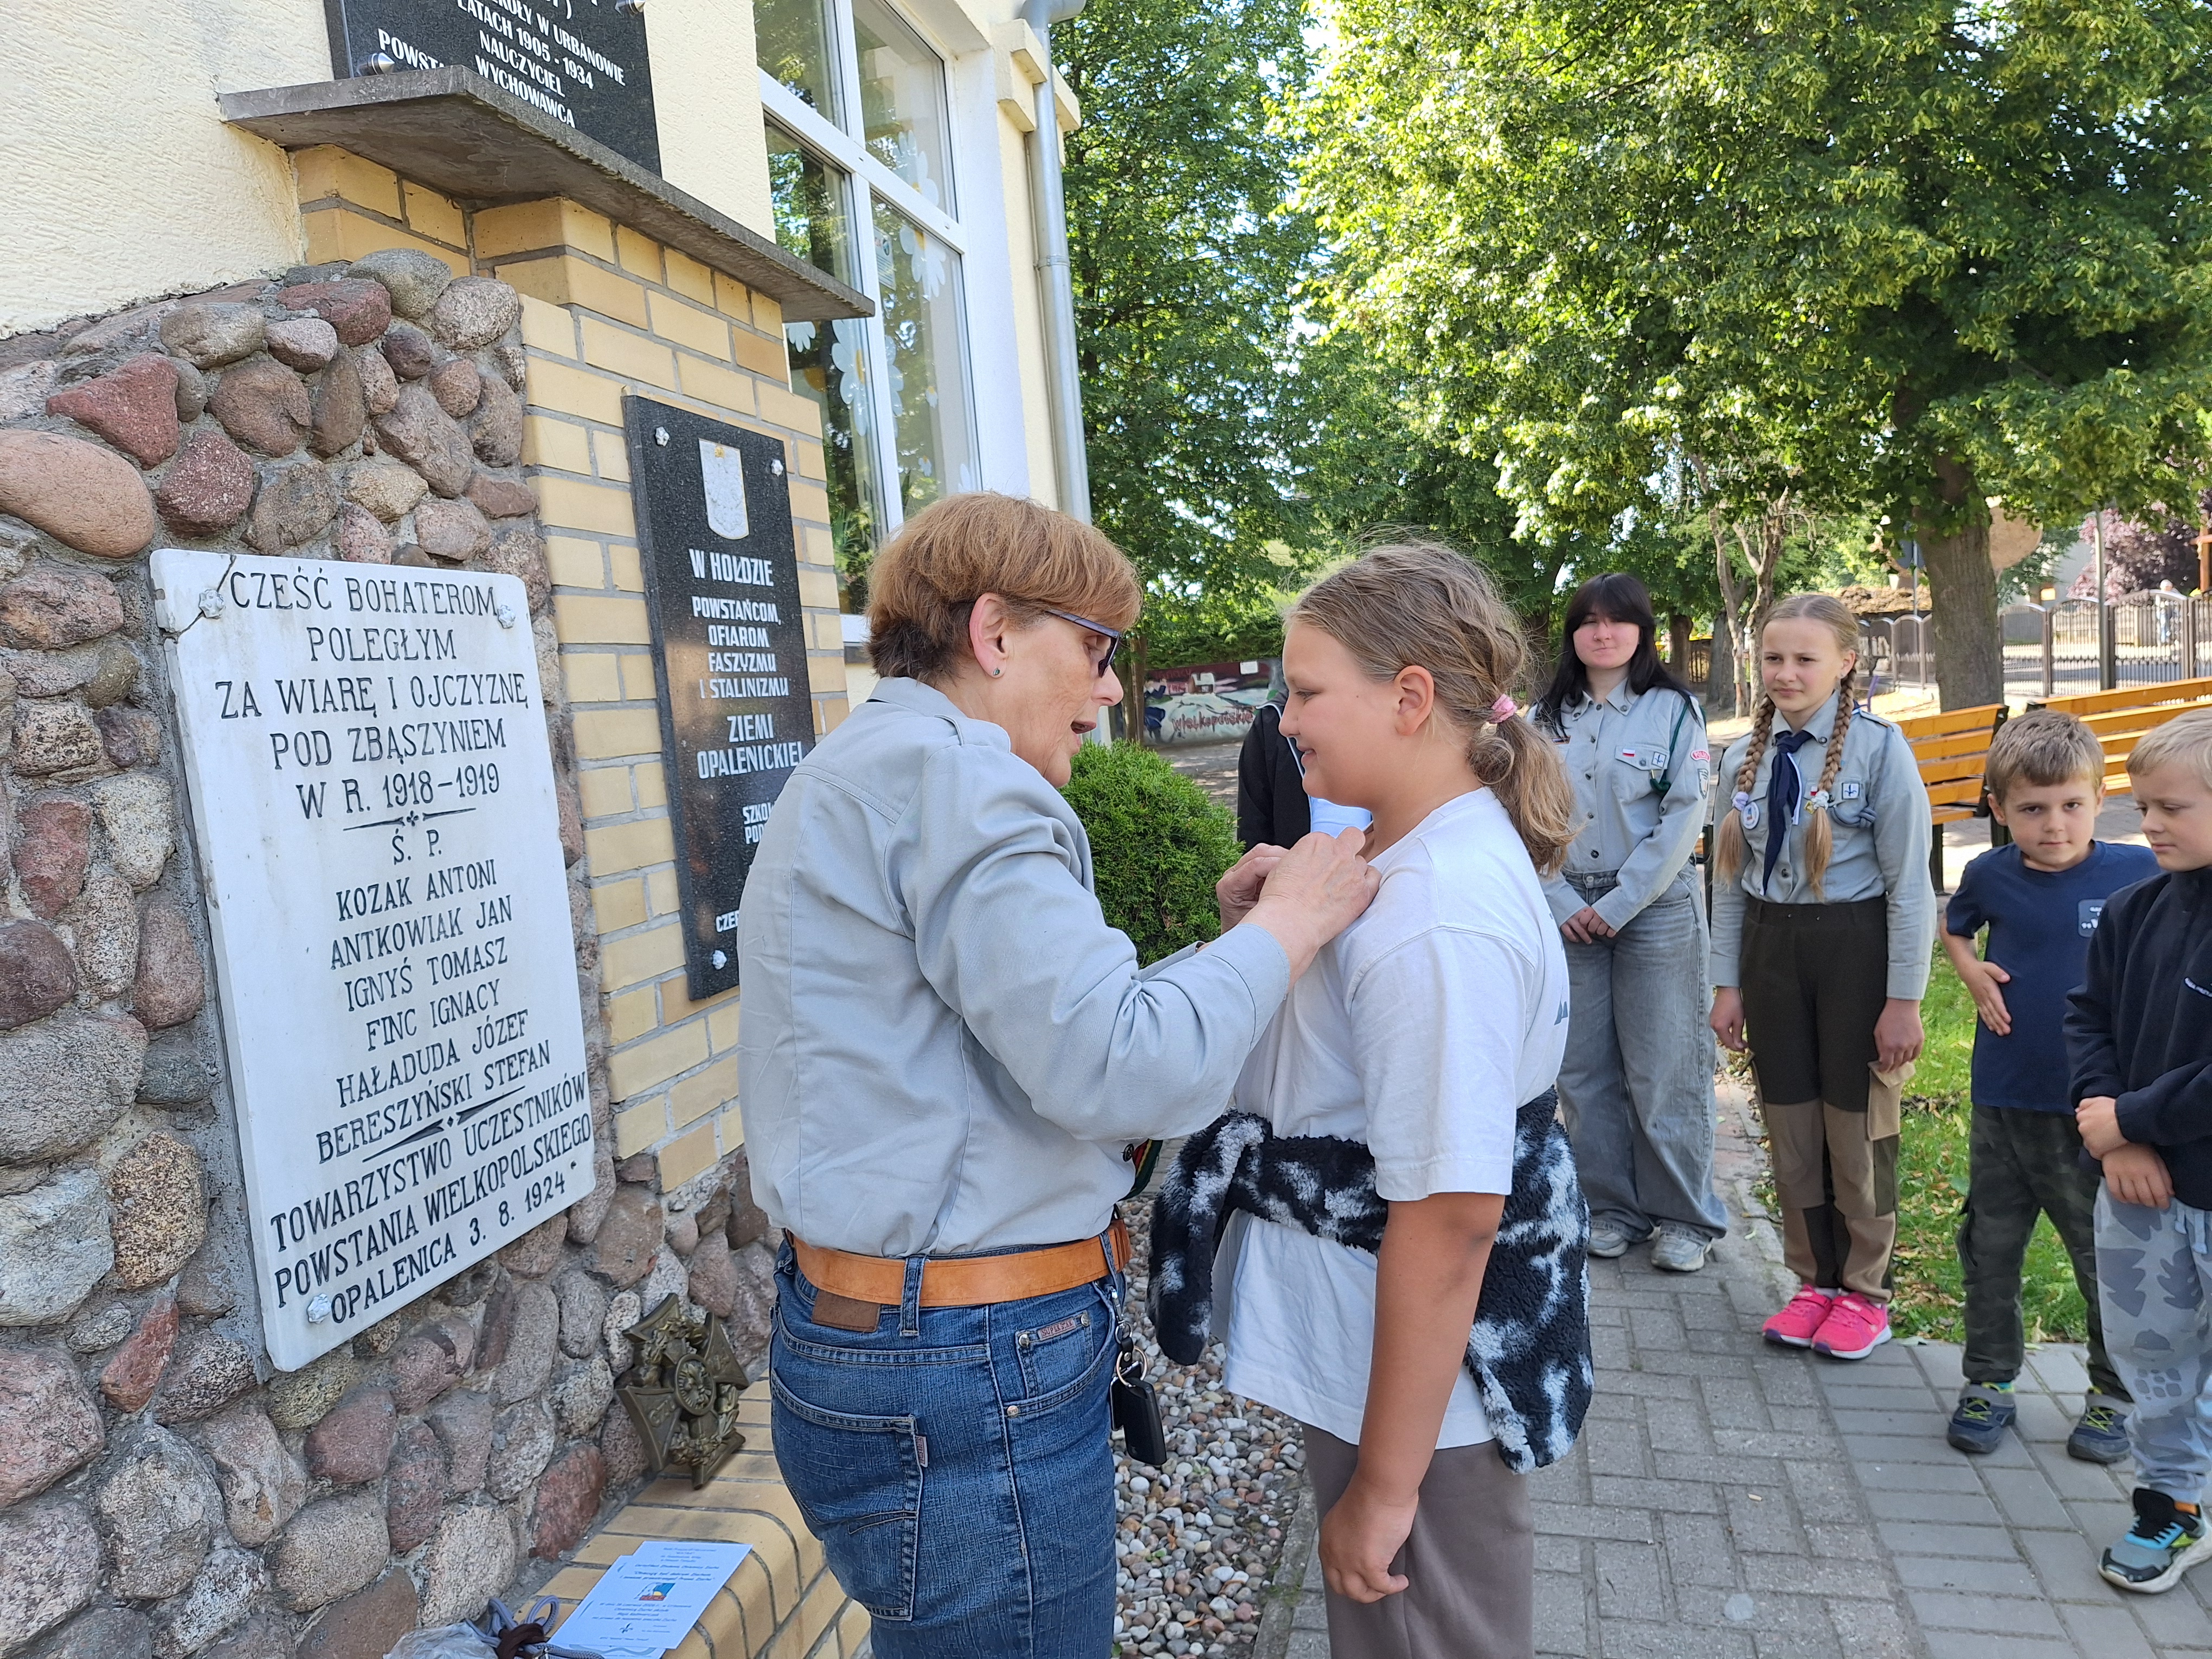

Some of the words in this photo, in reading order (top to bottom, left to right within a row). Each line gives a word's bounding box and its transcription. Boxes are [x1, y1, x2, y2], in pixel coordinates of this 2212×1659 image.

[378, 28, 445, 70] POWST
[479, 30, 565, 98] NAUCZYCIEL
[516, 27, 551, 63] 1905
[562, 57, 594, 90] 1934
[536, 12, 549, 36] W
[552, 24, 626, 87] URBANOWIE
[475, 54, 576, 128] WYCHOWAWCA
[229, 567, 332, 609] CZEŚĆ
[346, 577, 497, 616] BOHATEROM
[689, 548, 705, 579] W
[709, 551, 774, 587] HOŁDZIE
[691, 595, 781, 626] POWSTAŃCOM,
[307, 627, 457, 662] POLEGŁYM
[708, 625, 770, 648] OFIAROM
[708, 652, 777, 672] FASZYZMU
[215, 681, 261, 719] ZA
[275, 678, 377, 717] WIARĘ
[389, 676, 398, 709] I
[410, 673, 528, 709] OJCZYZNĘ
[699, 679, 705, 699] I
[709, 677, 790, 699] STALINIZMU
[270, 730, 331, 769] POD
[347, 718, 506, 763] ZBĄSZYNIEM
[726, 713, 774, 743] ZIEMI
[295, 781, 326, 819] W
[342, 779, 370, 814] R.
[391, 828, 411, 865] Ś.
[426, 829, 442, 857] P.
[336, 878, 413, 921] KOZAK
[426, 859, 497, 901] ANTONI
[330, 908, 464, 970] ANTKOWIAK
[477, 895, 512, 929] JAN
[344, 957, 413, 1011] IGNYŚ
[427, 937, 507, 986] TOMASZ
[366, 1009, 417, 1051] FINC
[430, 979, 500, 1028] IGNACY
[336, 1040, 460, 1107] HAŁADUDA
[472, 1009, 529, 1055] JÓZEF
[317, 1074, 473, 1163] BERESZYŃSKI
[484, 1040, 551, 1091] STEFAN
[271, 1138, 452, 1252] TOWARZYSTWO
[463, 1071, 586, 1157] UCZESTNIKÓW
[274, 1204, 420, 1308] POWSTANIA
[424, 1113, 591, 1226] WIELKOPOLSKIEGO
[331, 1233, 456, 1323] OPALENICA
[470, 1218, 487, 1247] 3.
[499, 1201, 515, 1227] 8.
[525, 1171, 566, 1214] 1924
[1041, 1320, 1073, 1336] SUPERSTAR
